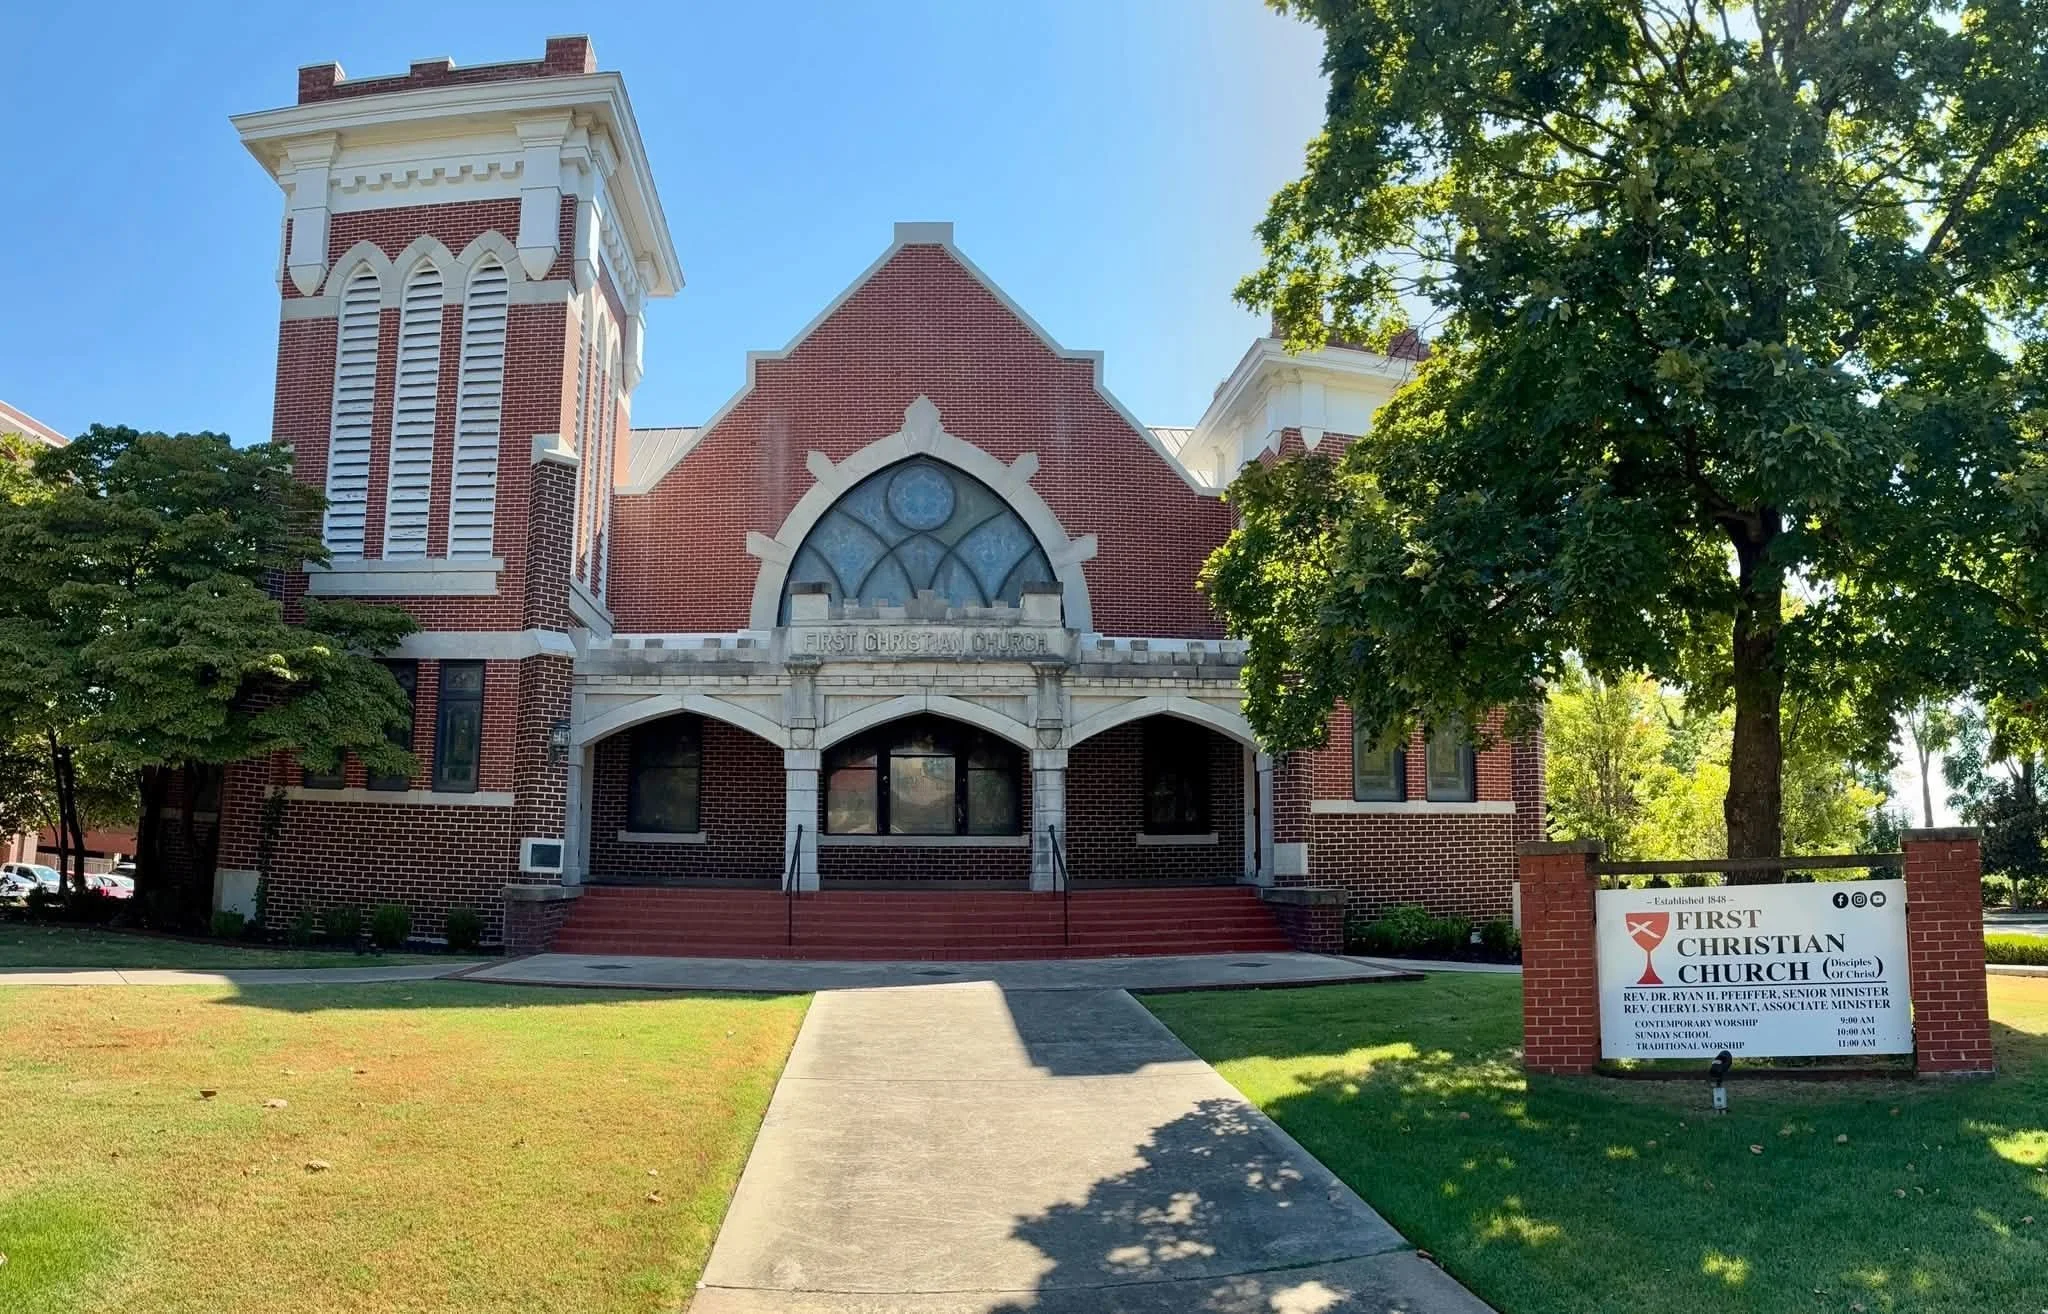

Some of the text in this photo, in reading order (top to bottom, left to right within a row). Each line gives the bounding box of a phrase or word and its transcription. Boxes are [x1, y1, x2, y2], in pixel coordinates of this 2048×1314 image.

[803, 631, 1049, 652] FIRST CHRISTIAN CHURCH
[1654, 895, 1727, 905] Established 1848
[1675, 909, 1762, 930] FIRST
[1677, 933, 1845, 957] CHRISTIAN
[1678, 961, 1810, 984] CHURCH
[1831, 970, 1843, 979] Of
[1623, 986, 1889, 1002] REV. DR. RYAN H. PFEIFFER, SENIOR MINISTER
[1624, 999, 1891, 1014] REV. CHERYL SYBRANT, ASSOCIATE MINISTER
[1635, 1019, 1758, 1028] CONTEMPORARY WORSHIP
[1840, 1016, 1875, 1024] 9:00 AM
[1635, 1031, 1712, 1039] SUNDAY SCHOOL
[1837, 1027, 1875, 1036] 10:00 AM
[1636, 1041, 1745, 1050] TRADITIONAL WORSHIP
[1838, 1039, 1876, 1047] 11:00 AM
